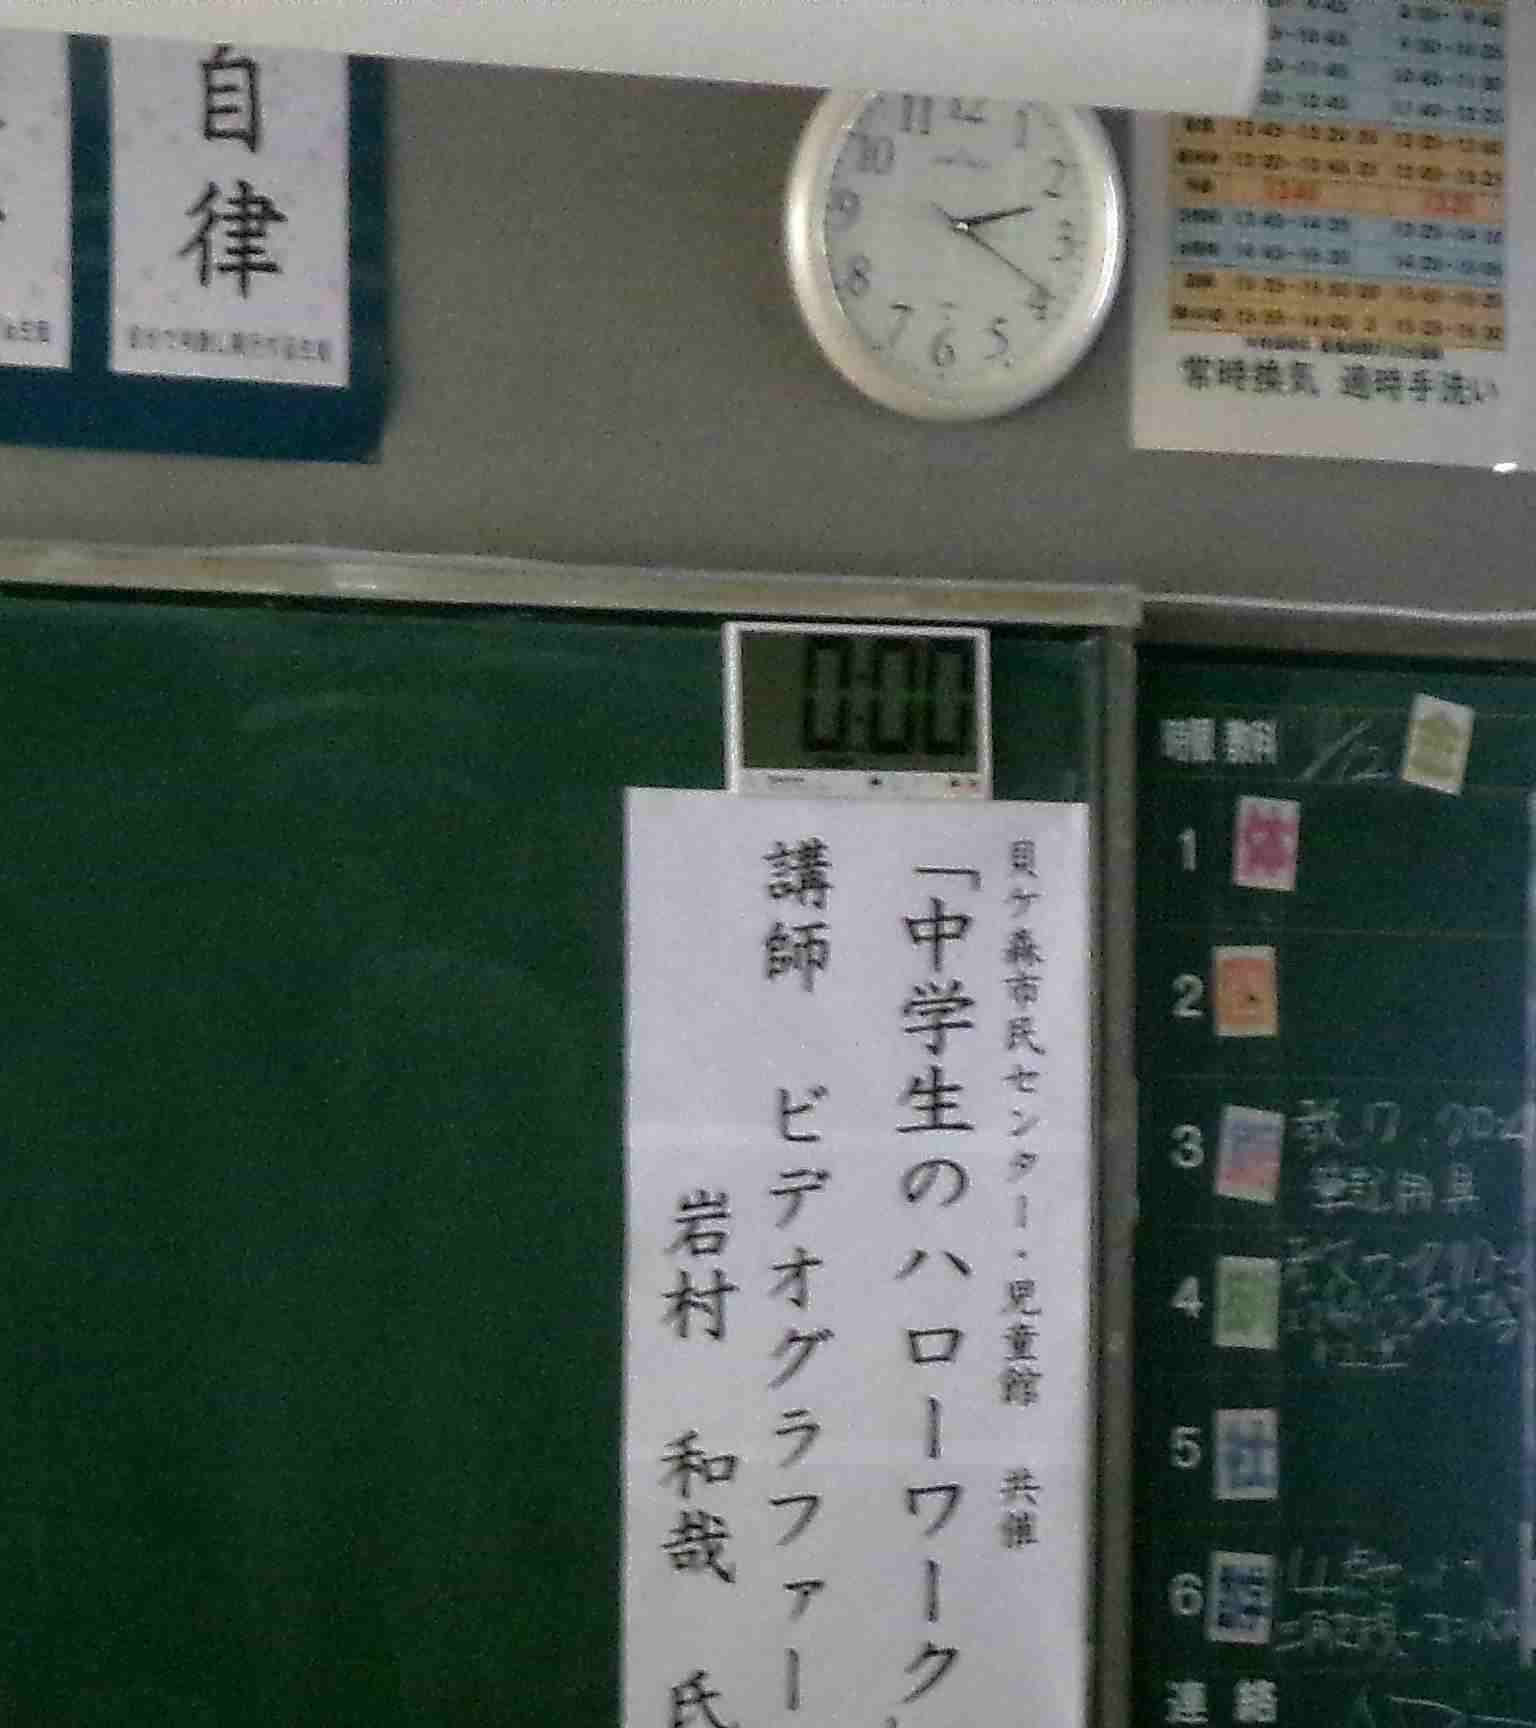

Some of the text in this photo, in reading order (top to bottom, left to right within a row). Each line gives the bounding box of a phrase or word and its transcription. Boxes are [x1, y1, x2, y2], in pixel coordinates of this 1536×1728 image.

[900, 94, 933, 135] 11
[177, 43, 290, 299] 自律
[1178, 827, 1198, 872] 1
[762, 836, 834, 993] 講師
[1172, 973, 1204, 1019] 2
[1170, 1123, 1205, 1169] 3
[661, 1186, 740, 1342] 岩村
[1170, 1274, 1204, 1320] 4
[767, 1084, 837, 1714] ビデオグラファー
[1170, 1424, 1203, 1470] 5
[660, 1430, 740, 1585] 和哉
[1169, 1571, 1205, 1618] 6
